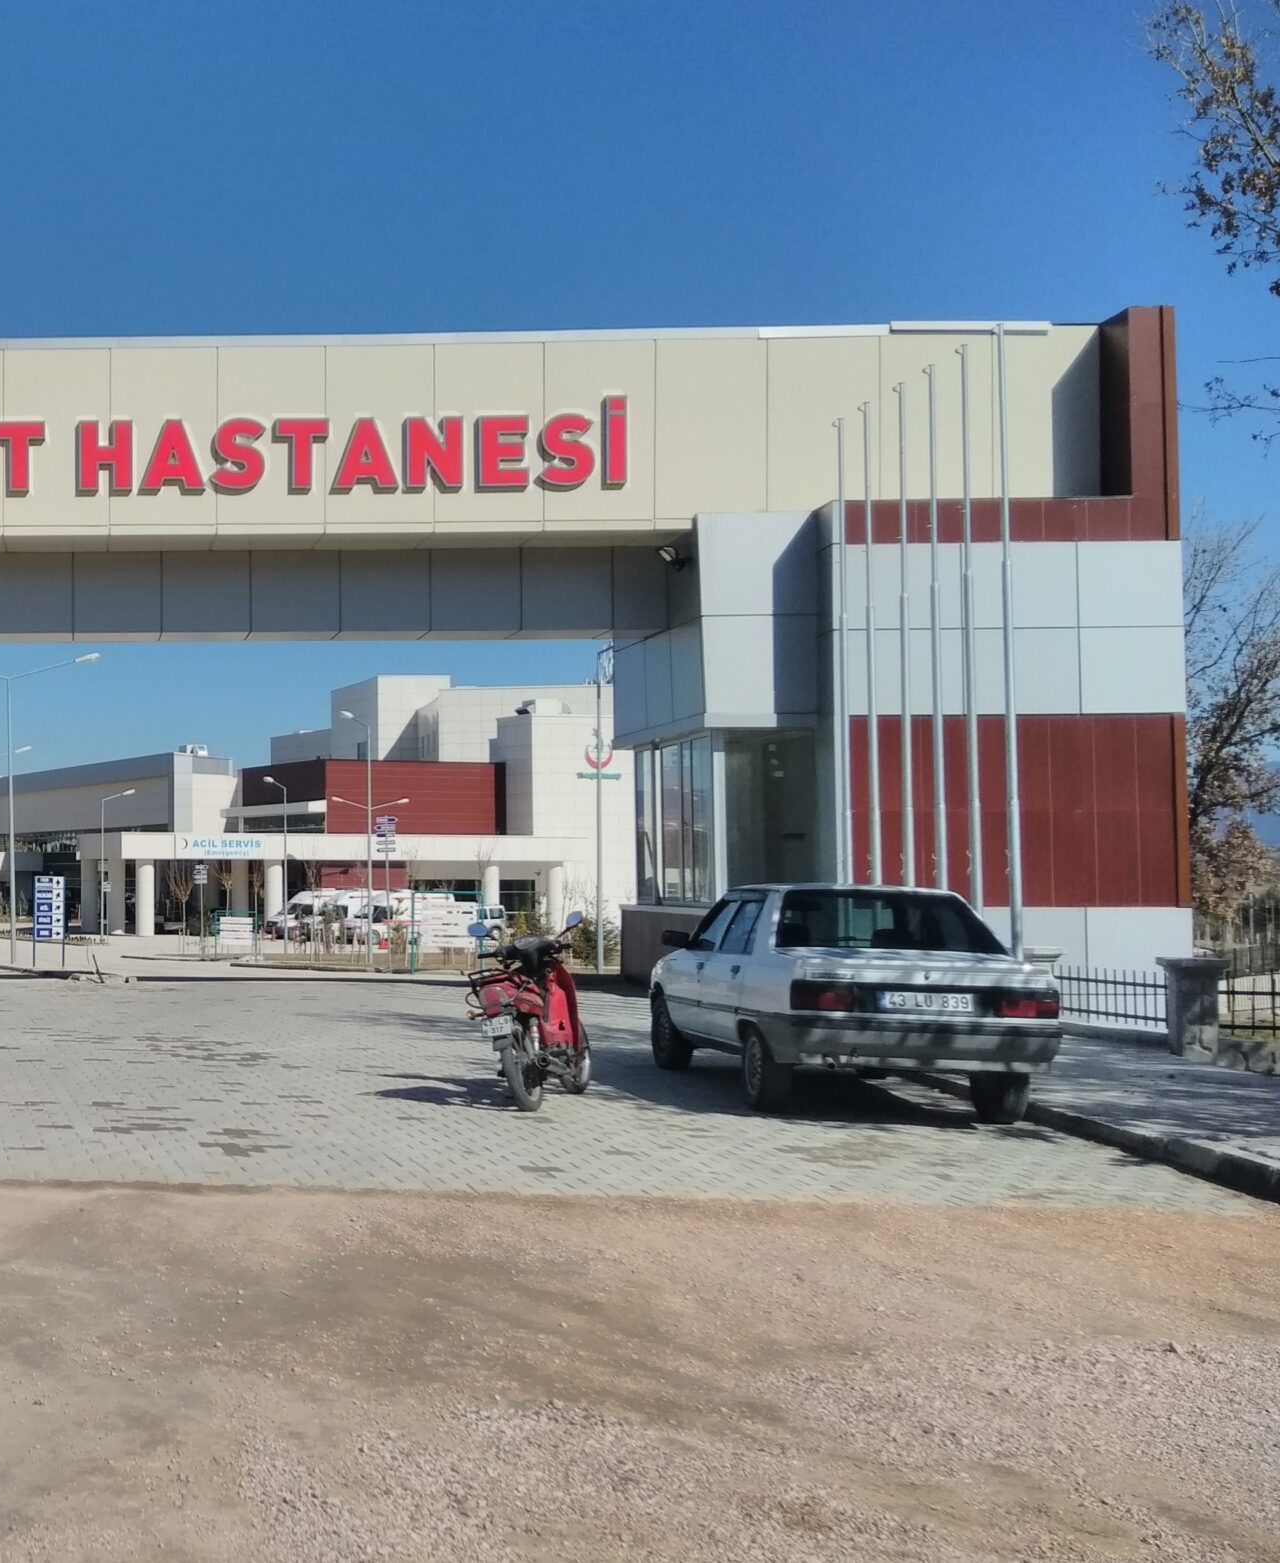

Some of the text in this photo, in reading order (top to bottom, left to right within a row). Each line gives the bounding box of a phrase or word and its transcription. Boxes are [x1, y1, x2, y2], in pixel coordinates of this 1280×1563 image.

[75, 394, 628, 497] HASTANESİ
[192, 837, 262, 848] ACİL SERVİS
[888, 993, 970, 1010] 43 LU 839
